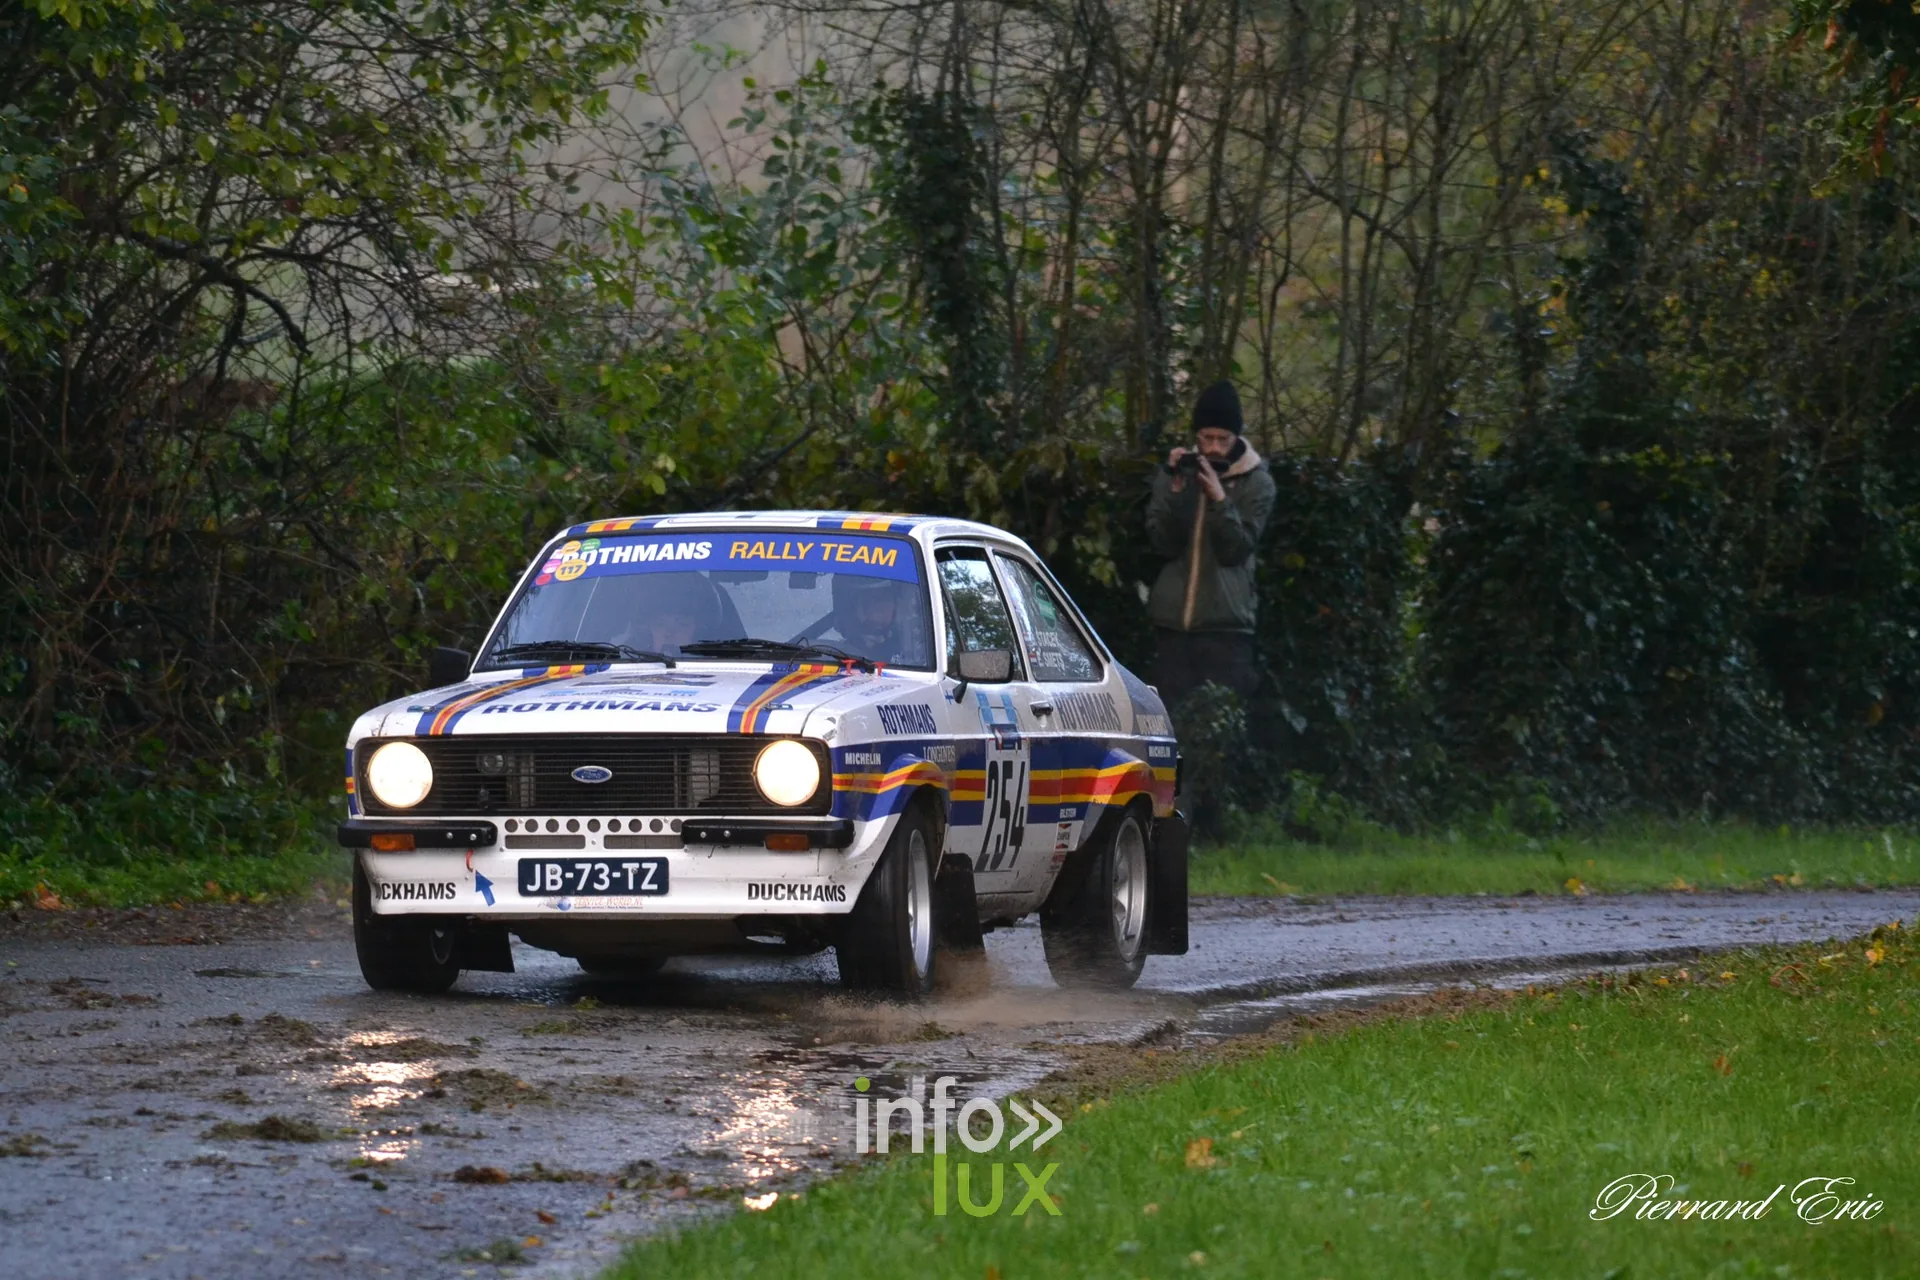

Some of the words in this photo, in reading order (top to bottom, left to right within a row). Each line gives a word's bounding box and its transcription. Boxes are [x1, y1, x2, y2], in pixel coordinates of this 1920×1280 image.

[729, 541, 814, 560] RALLY
[820, 543, 897, 567] TEAM
[559, 564, 584, 577] 117
[481, 700, 722, 715] ROTHMANS
[1051, 692, 1122, 731] ROTHMANS
[876, 703, 937, 735] ROTHMANS
[845, 752, 881, 765] MICHELIN
[923, 745, 956, 763] LONGINES
[974, 760, 1026, 872] 254
[526, 862, 659, 892] JB-73-TZ
[376, 882, 456, 900] CKHAMS
[747, 882, 846, 902] DUCKHAMS
